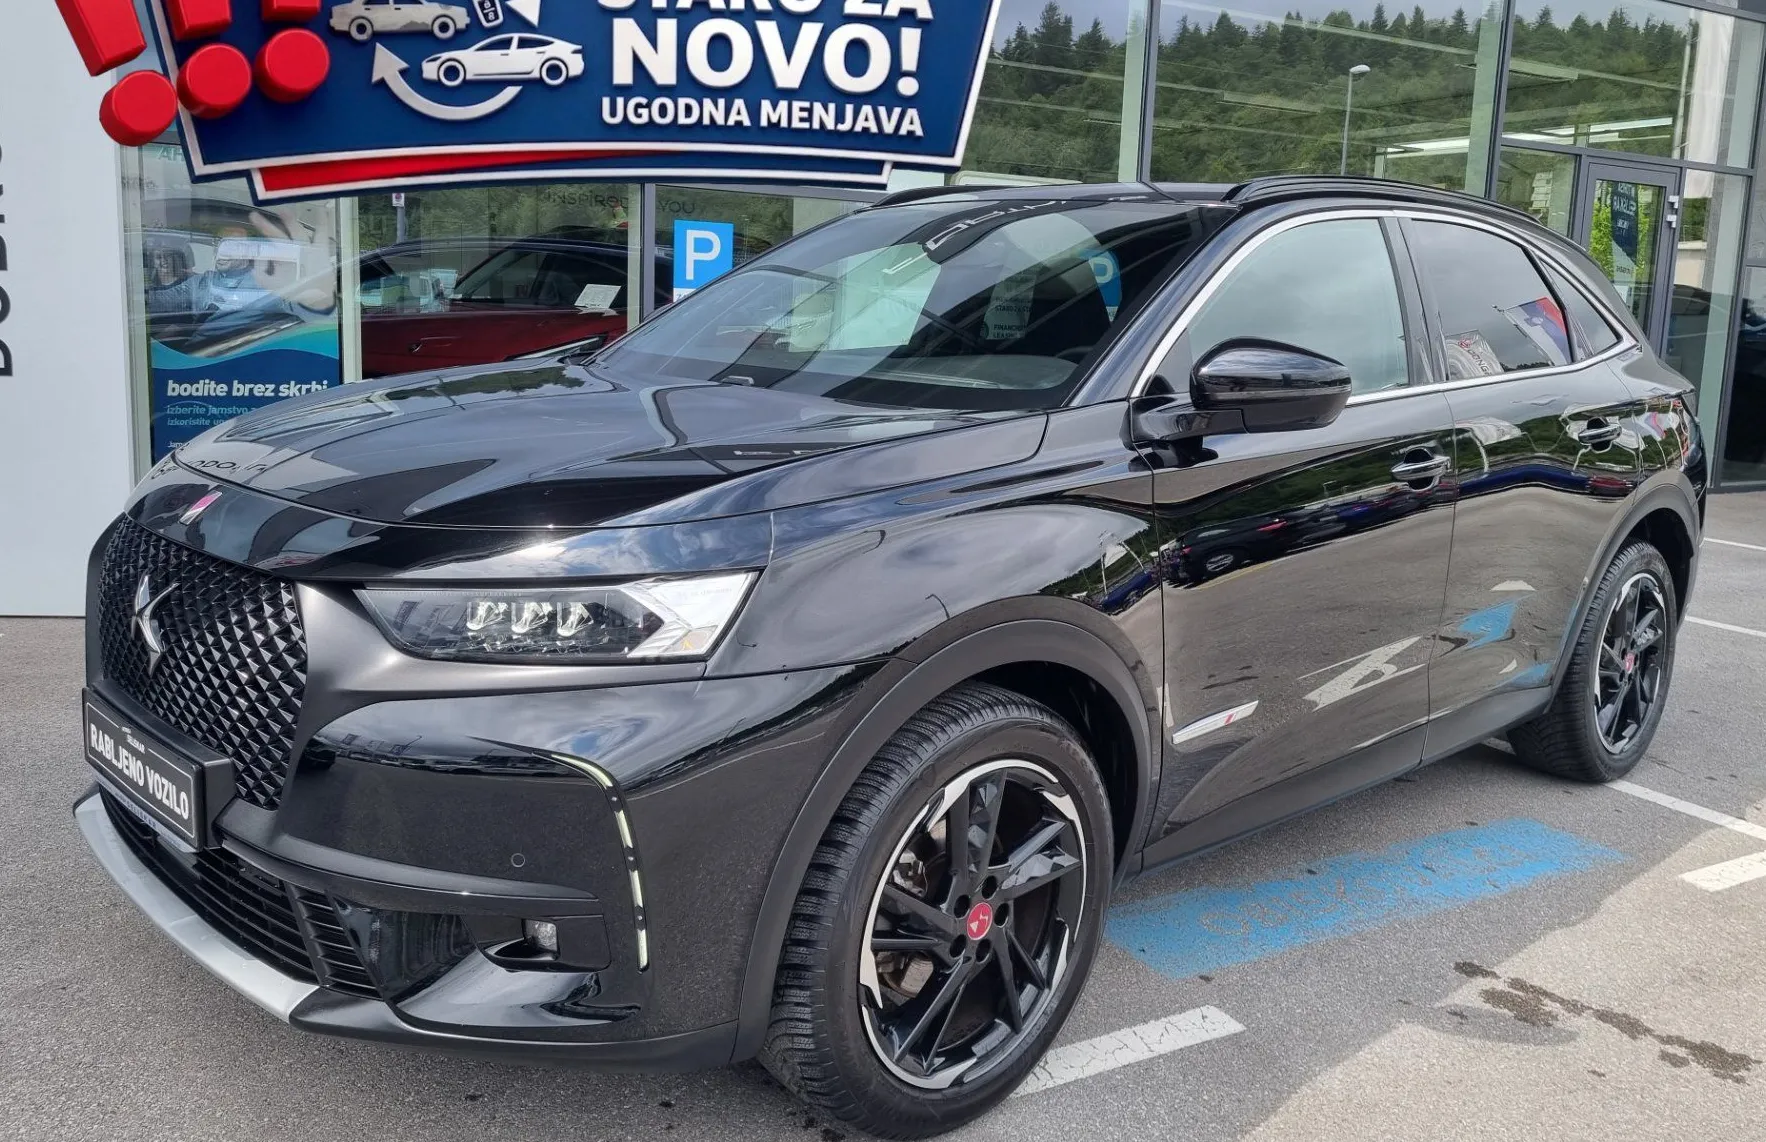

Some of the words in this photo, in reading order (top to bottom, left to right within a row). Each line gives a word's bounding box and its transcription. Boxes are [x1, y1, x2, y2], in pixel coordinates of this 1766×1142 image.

[685, 229, 722, 280] P
[167, 379, 229, 396] bodite
[232, 380, 276, 397] brez
[166, 405, 206, 415] izberite
[167, 418, 211, 426] izkoristite
[90, 723, 145, 787] RABLJENO
[146, 766, 190, 820] VOZILO
